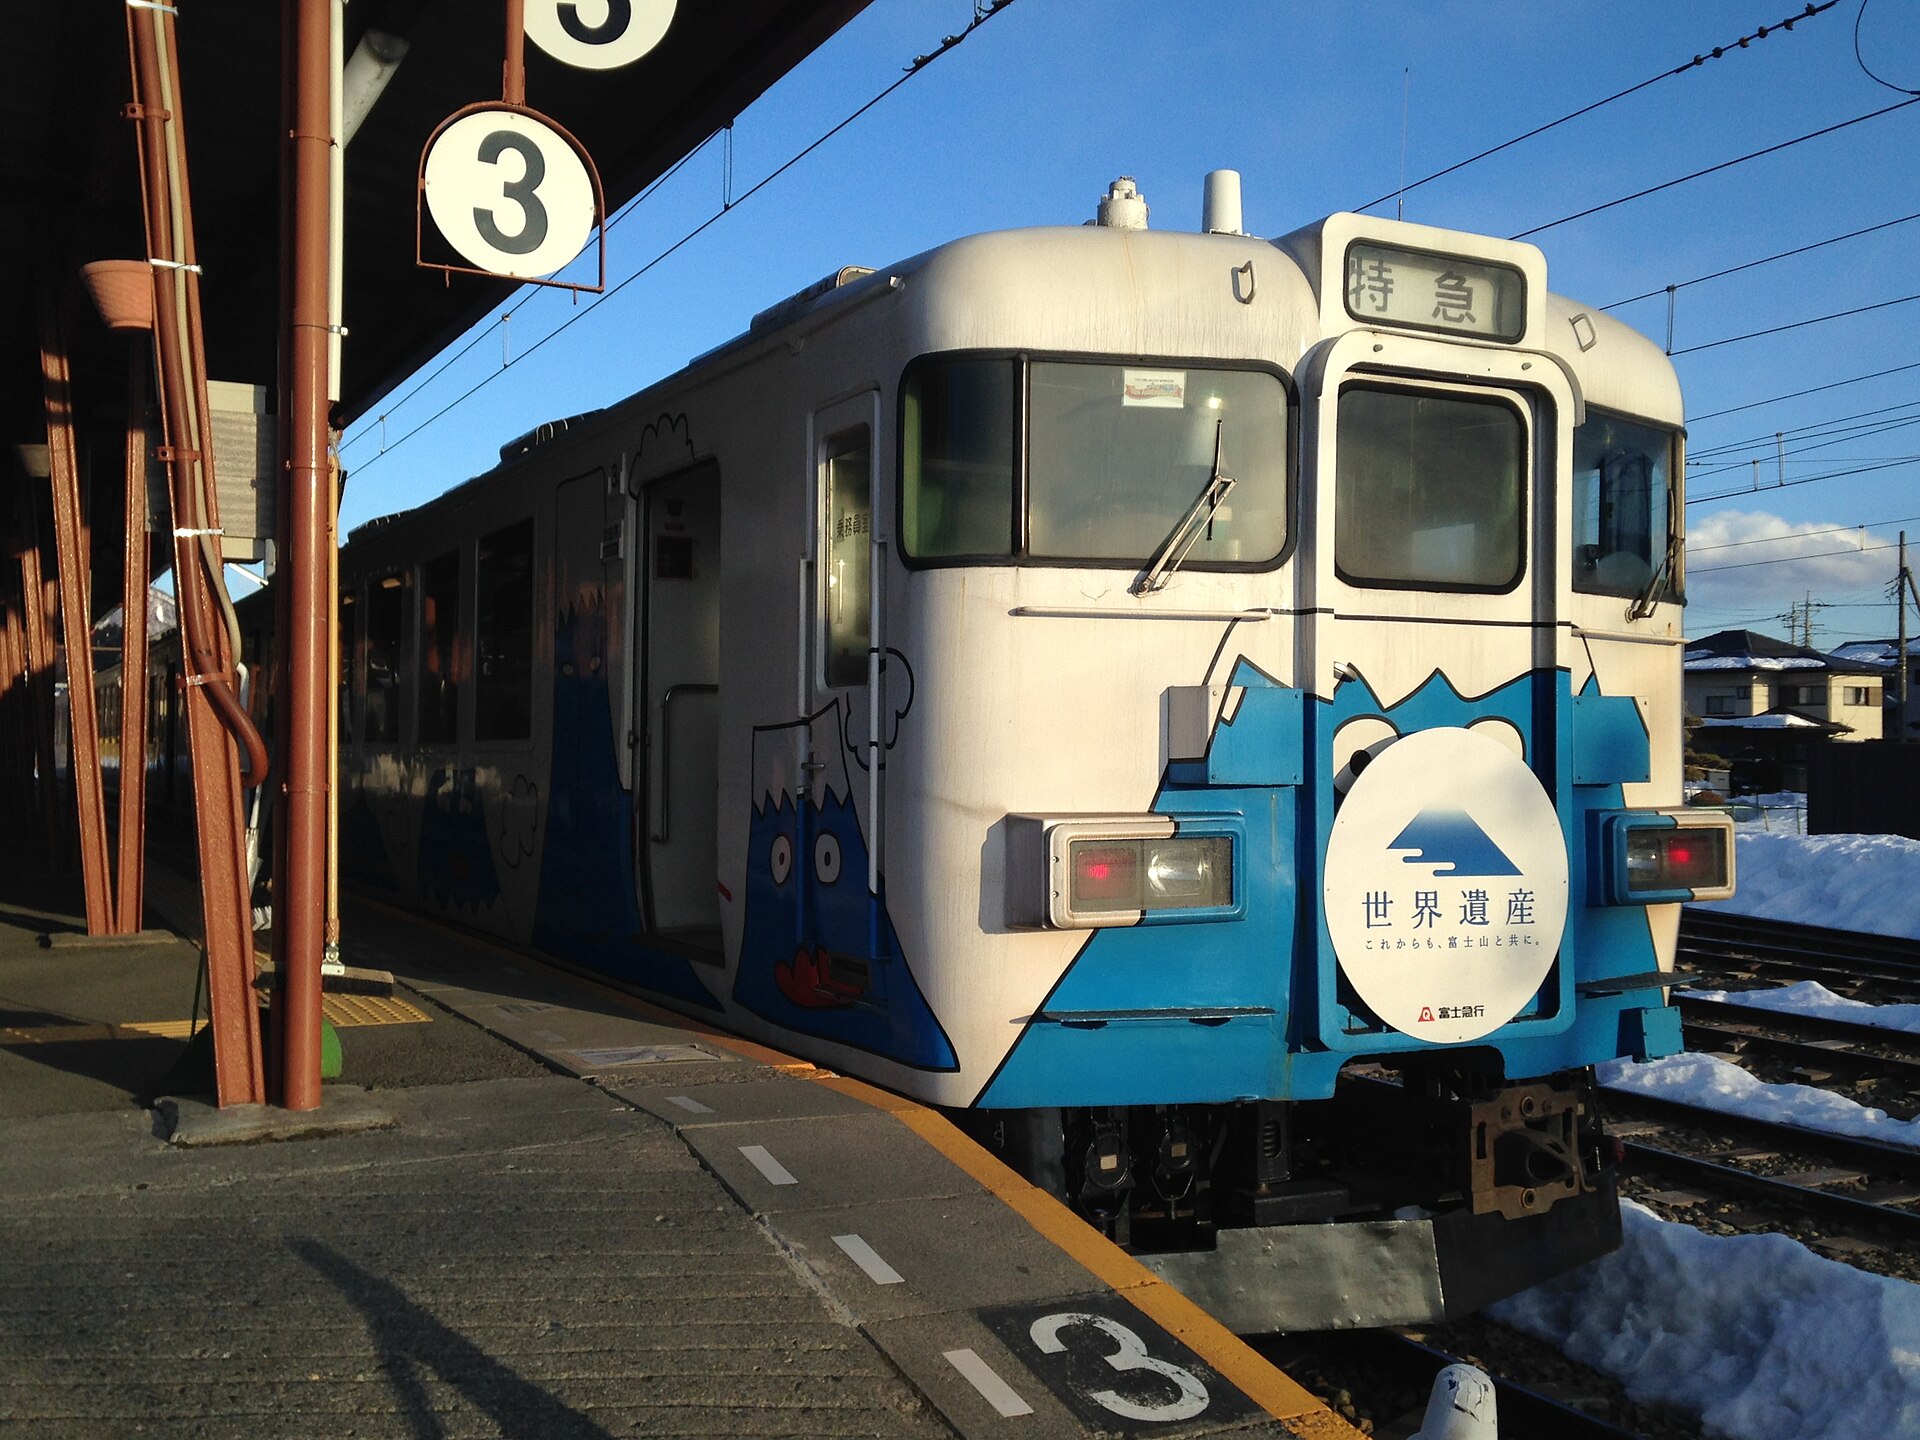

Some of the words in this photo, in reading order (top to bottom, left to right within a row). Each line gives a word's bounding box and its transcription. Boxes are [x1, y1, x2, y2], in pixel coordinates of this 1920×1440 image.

[473, 130, 548, 255] 3
[1350, 256, 1476, 323] 特急
[1362, 888, 1535, 929] 世界遺産
[1438, 1005, 1485, 1019] 富士急行
[1030, 1313, 1210, 1421] 3
